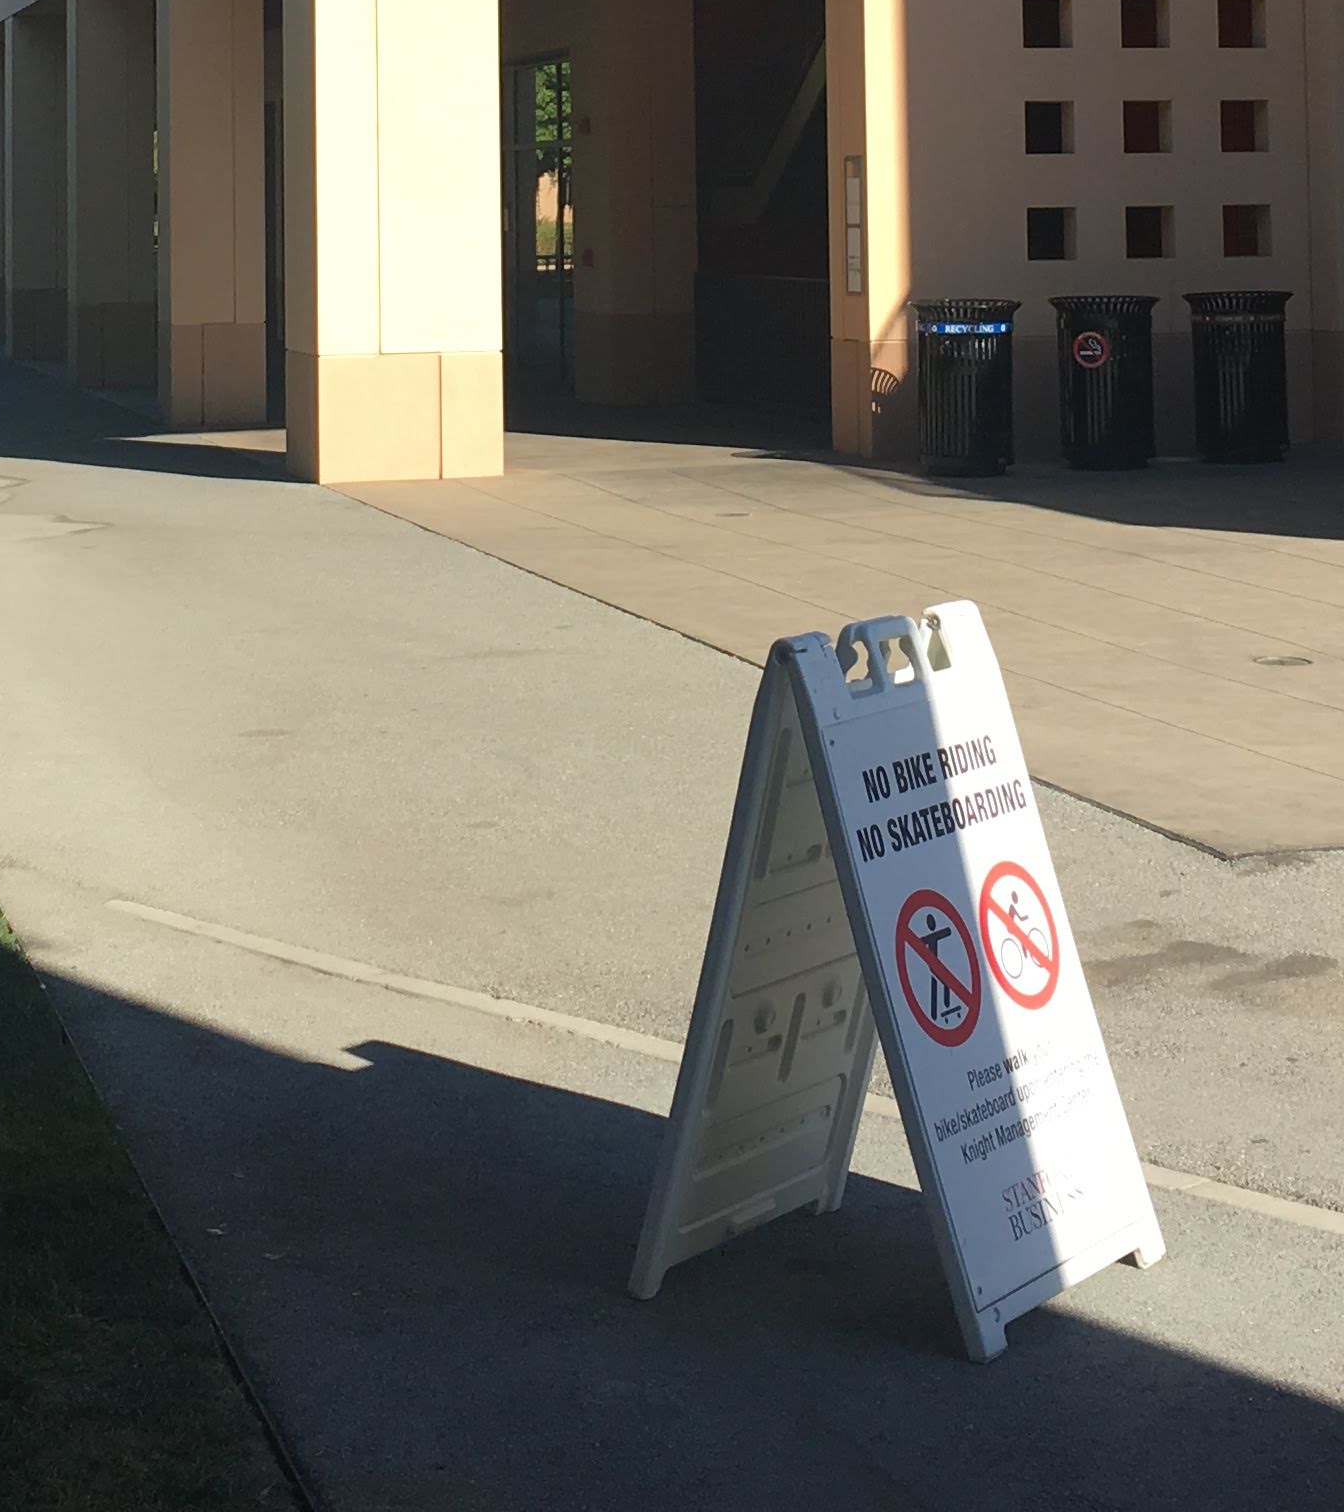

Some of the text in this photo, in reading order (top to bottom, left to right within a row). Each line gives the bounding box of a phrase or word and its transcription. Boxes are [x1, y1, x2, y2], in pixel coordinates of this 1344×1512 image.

[944, 323, 994, 334] RECYCLING
[862, 734, 997, 804] NO BIKE RIDING
[856, 779, 1027, 863] NO SKATEBOARDING
[967, 1062, 1003, 1091] Please
[1003, 1048, 1029, 1075] walk
[934, 1086, 1016, 1142] bike/skateboard
[960, 1132, 997, 1165] Knight
[1002, 1168, 1073, 1212] STANF
[1008, 1187, 1084, 1242] BUSIN
